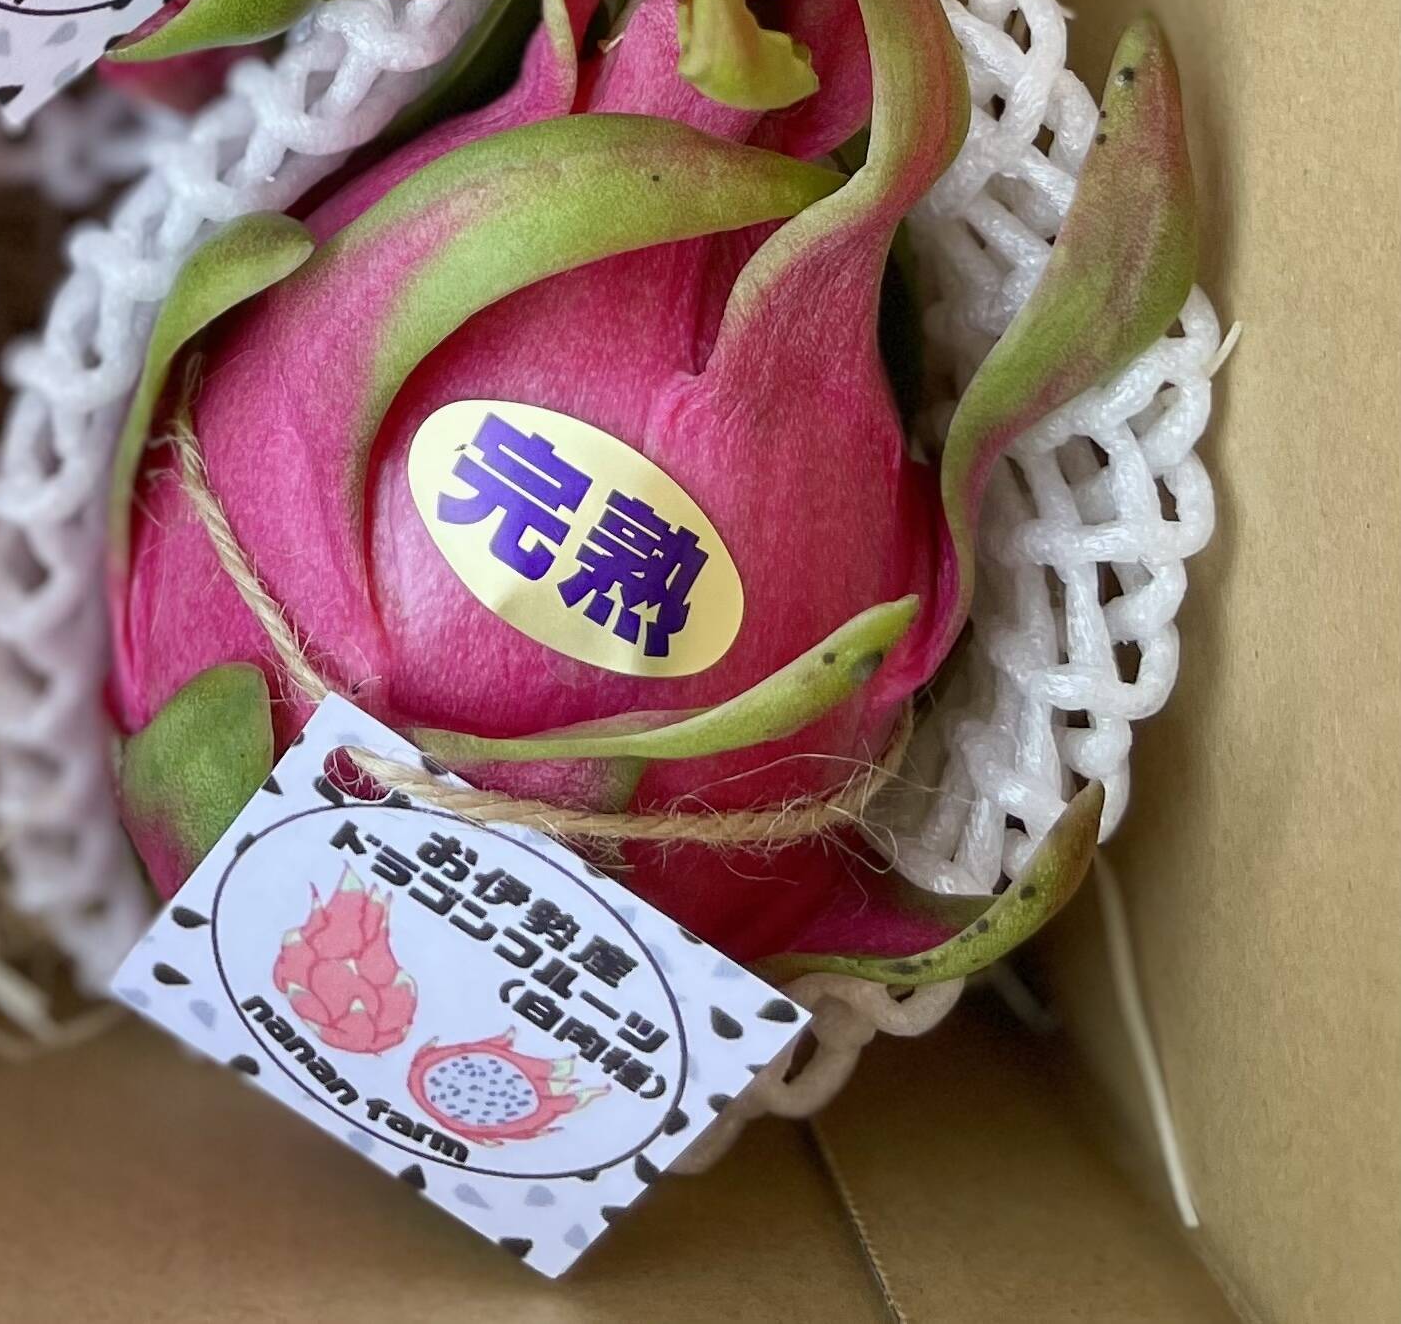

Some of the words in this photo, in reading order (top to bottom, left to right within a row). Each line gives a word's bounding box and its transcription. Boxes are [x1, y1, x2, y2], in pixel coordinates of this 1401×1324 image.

[437, 412, 709, 657] 完熟
[330, 819, 669, 1054] ドラゴンフルーツ
[416, 832, 639, 988] お伊勢産
[240, 995, 361, 1106] nanan
[366, 1097, 470, 1163] farm
